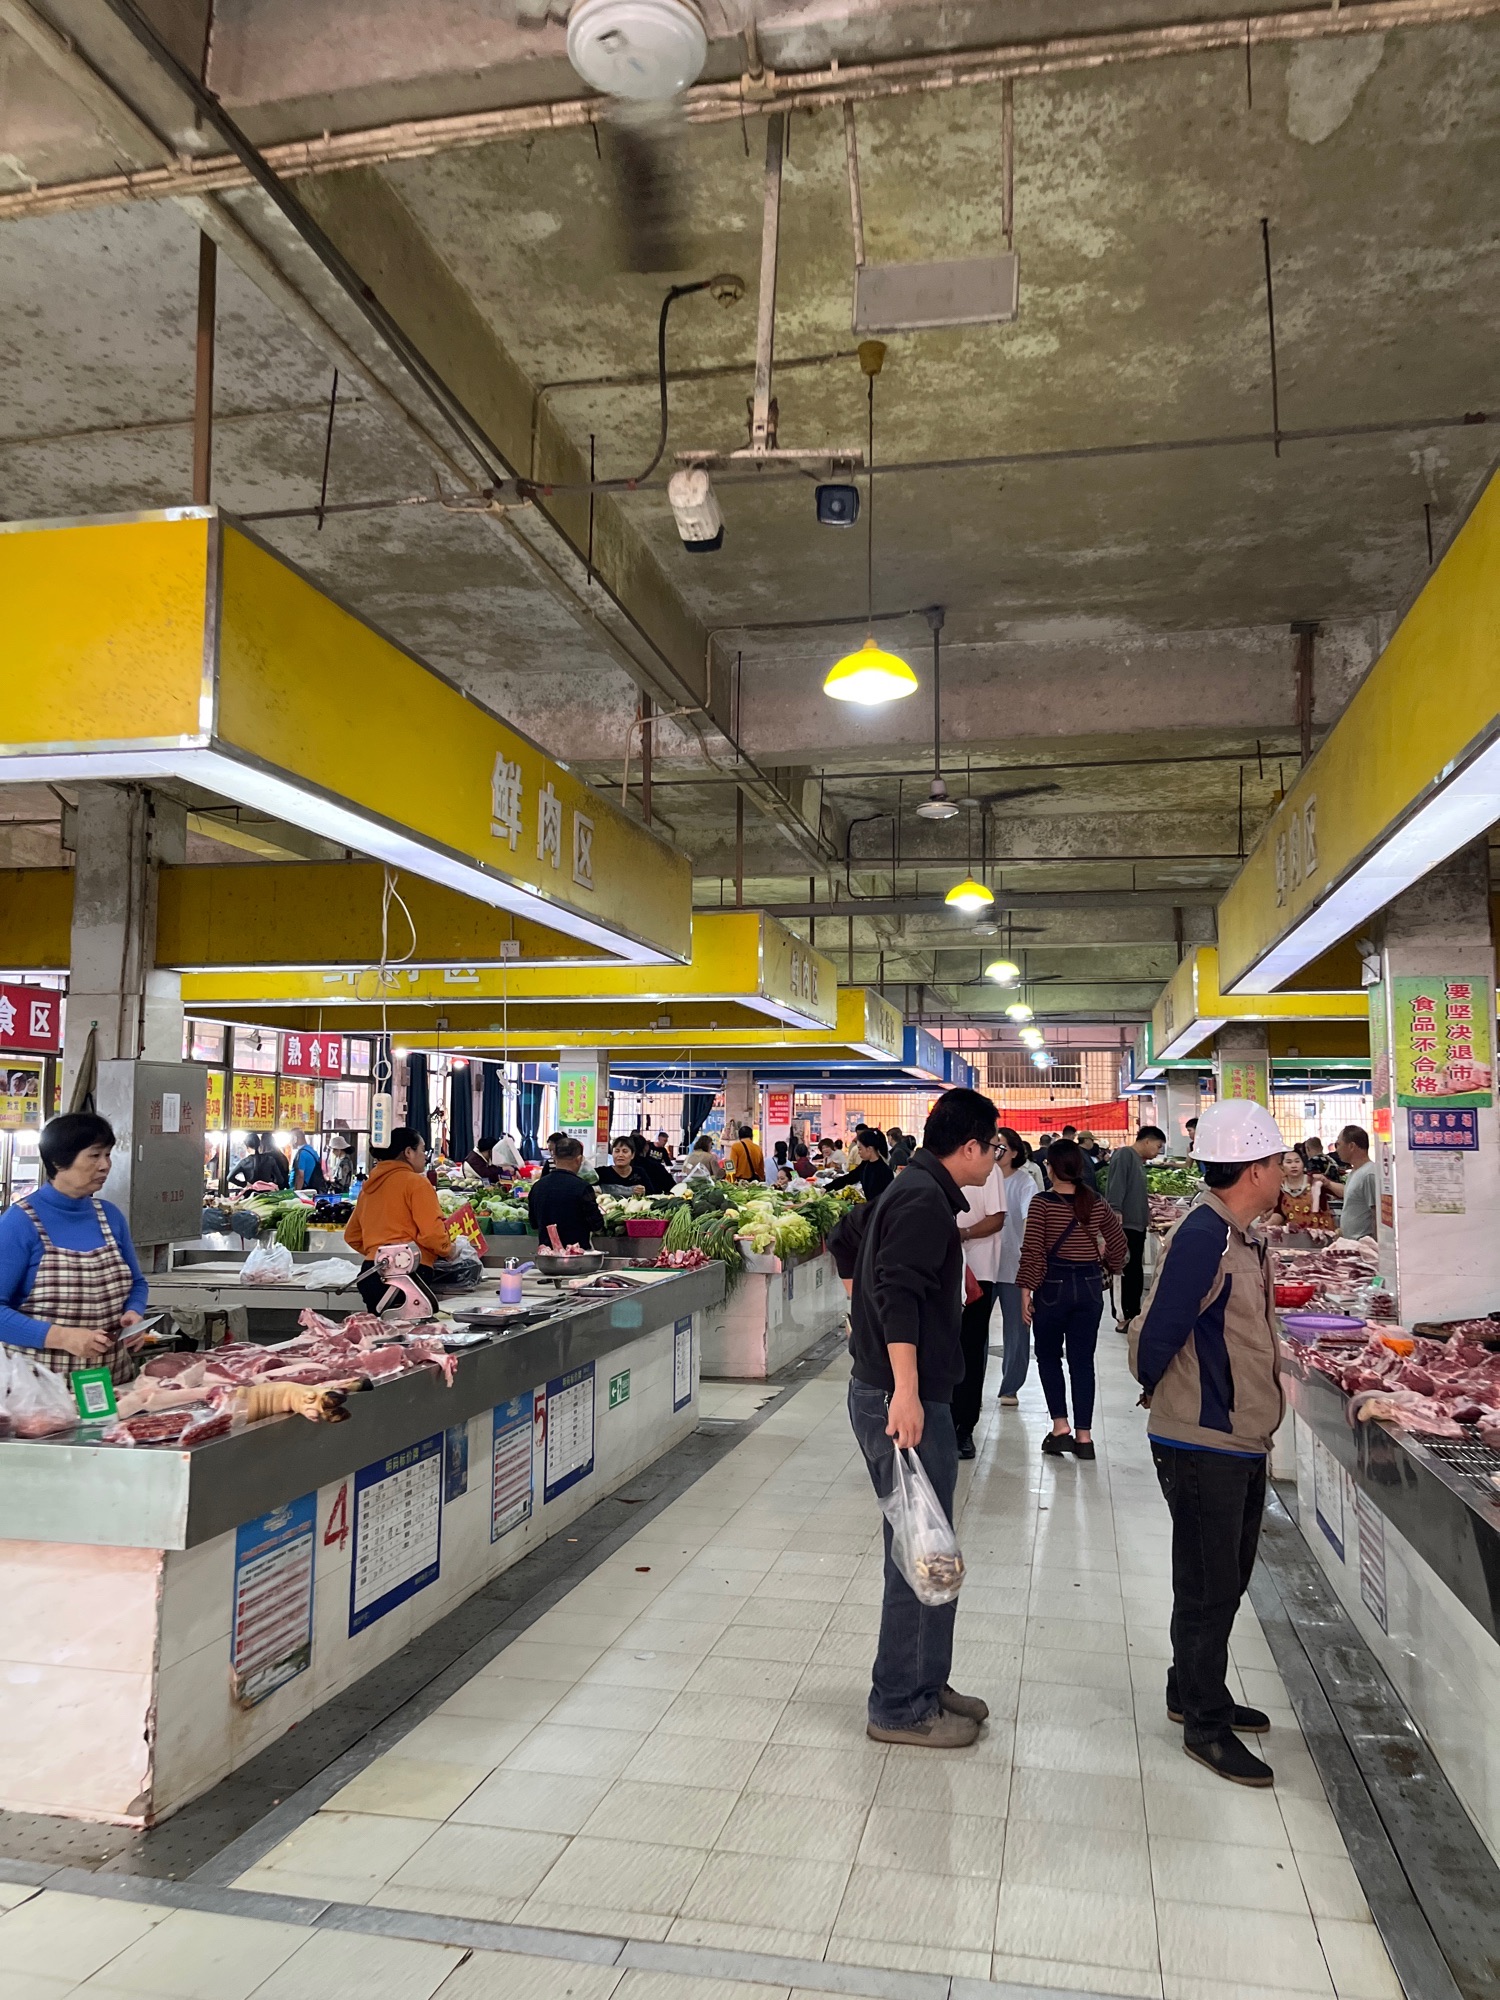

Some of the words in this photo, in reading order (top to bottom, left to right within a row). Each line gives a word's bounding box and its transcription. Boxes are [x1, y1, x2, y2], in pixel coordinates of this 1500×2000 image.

[490, 751, 594, 890] 鲜肉区
[790, 950, 818, 1006] 鲜肉区
[288, 1036, 339, 1069] 熟食区
[1410, 996, 1437, 1093] 食品不合格
[1446, 984, 1474, 1080] 要坚决退市
[150, 1101, 192, 1120] 消栓
[239, 1076, 264, 1089] 吴姐
[534, 1393, 546, 1447] 5
[324, 1481, 349, 1551] 4
